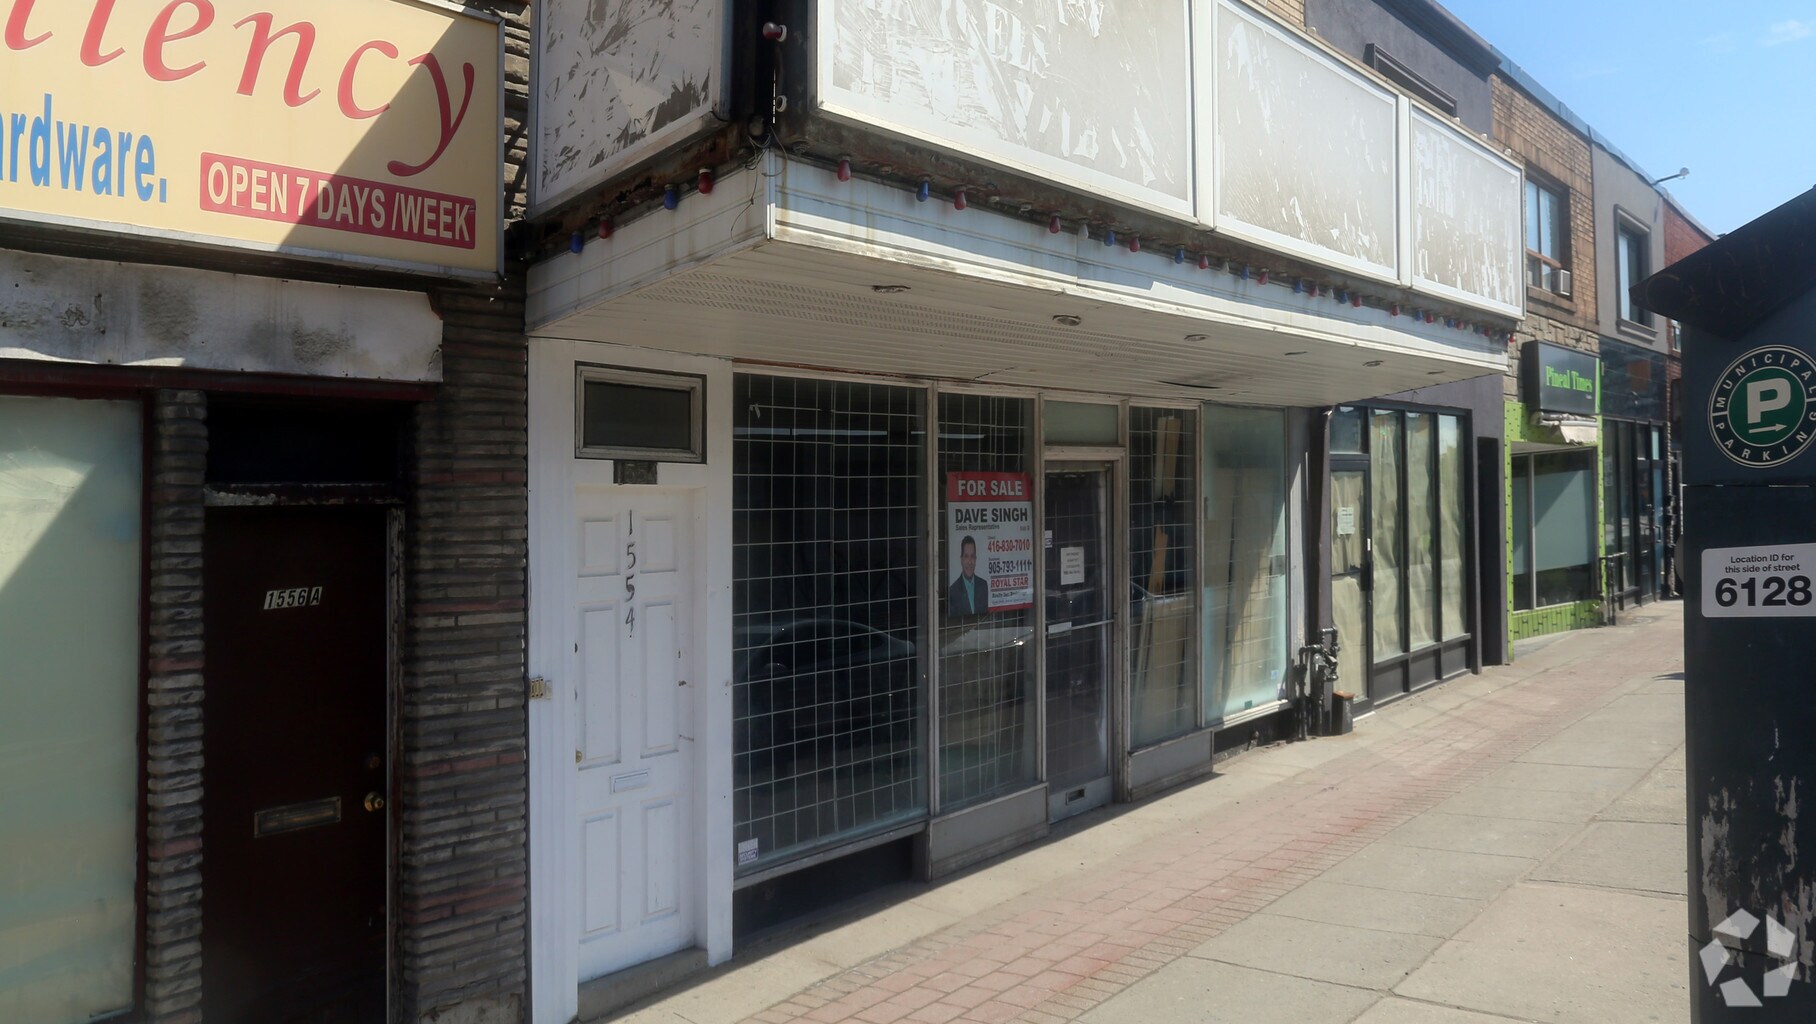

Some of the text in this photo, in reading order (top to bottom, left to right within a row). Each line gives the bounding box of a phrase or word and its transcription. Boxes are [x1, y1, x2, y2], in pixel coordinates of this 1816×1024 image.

[0, 92, 167, 203] rdware.
[208, 162, 287, 214] OPEN
[296, 177, 310, 217] 7
[317, 179, 386, 228] DAYS
[1715, 353, 1816, 408] MUNICIPAL
[1747, 378, 1791, 424] P
[1715, 411, 1816, 461] PARKING
[958, 479, 1023, 496] FOR SALE
[955, 507, 1028, 524] DAVE SINGH
[988, 539, 1030, 553] 416-830-7010
[1725, 563, 1800, 573] this side of street
[1730, 553, 1795, 564] Location ID for
[991, 577, 1028, 588] ROYAL STAR
[1715, 575, 1813, 607] 6128
